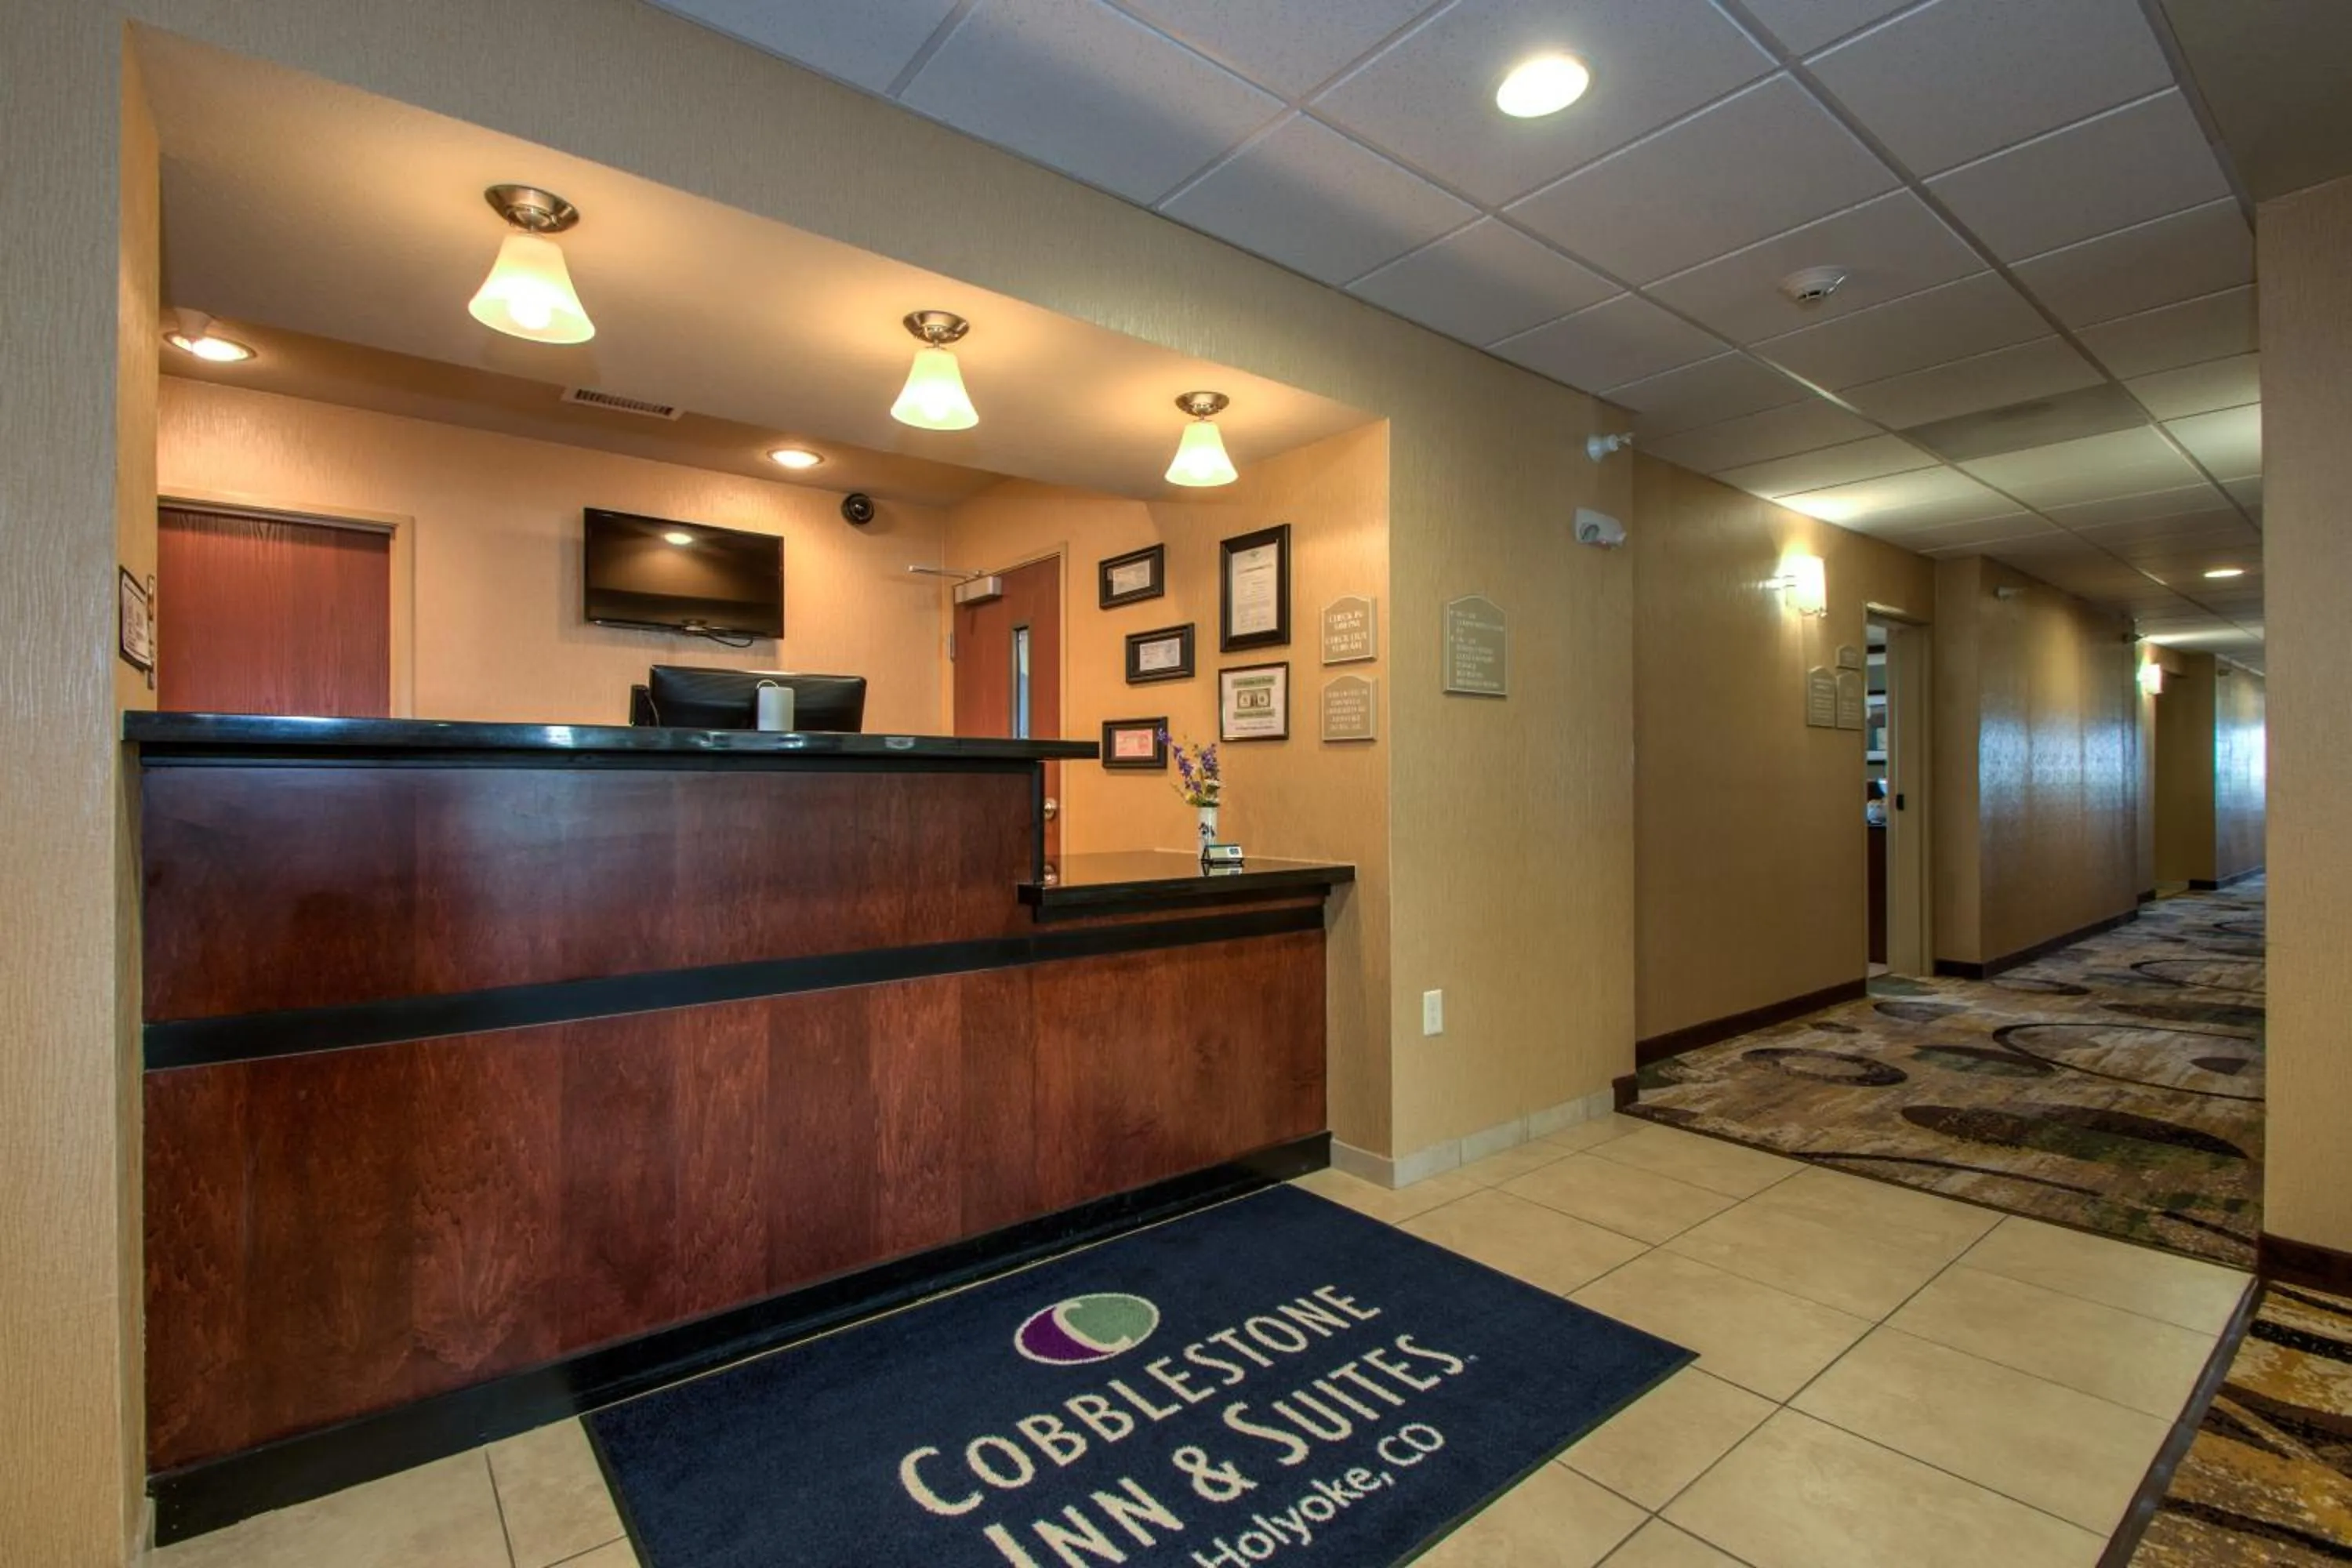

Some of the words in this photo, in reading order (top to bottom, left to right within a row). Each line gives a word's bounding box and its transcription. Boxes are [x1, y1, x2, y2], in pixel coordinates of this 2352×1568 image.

[1325, 634, 1348, 645] CHECK
[1329, 612, 1352, 622] CHECK
[899, 1286, 1382, 1516] COBBLESTONE
[983, 1477, 1185, 1568] INN
[1172, 1446, 1258, 1502] &
[1222, 1334, 1465, 1466] SUITES
[1191, 1467, 1396, 1568] Holyoke,
[1377, 1423, 1445, 1467] CO
